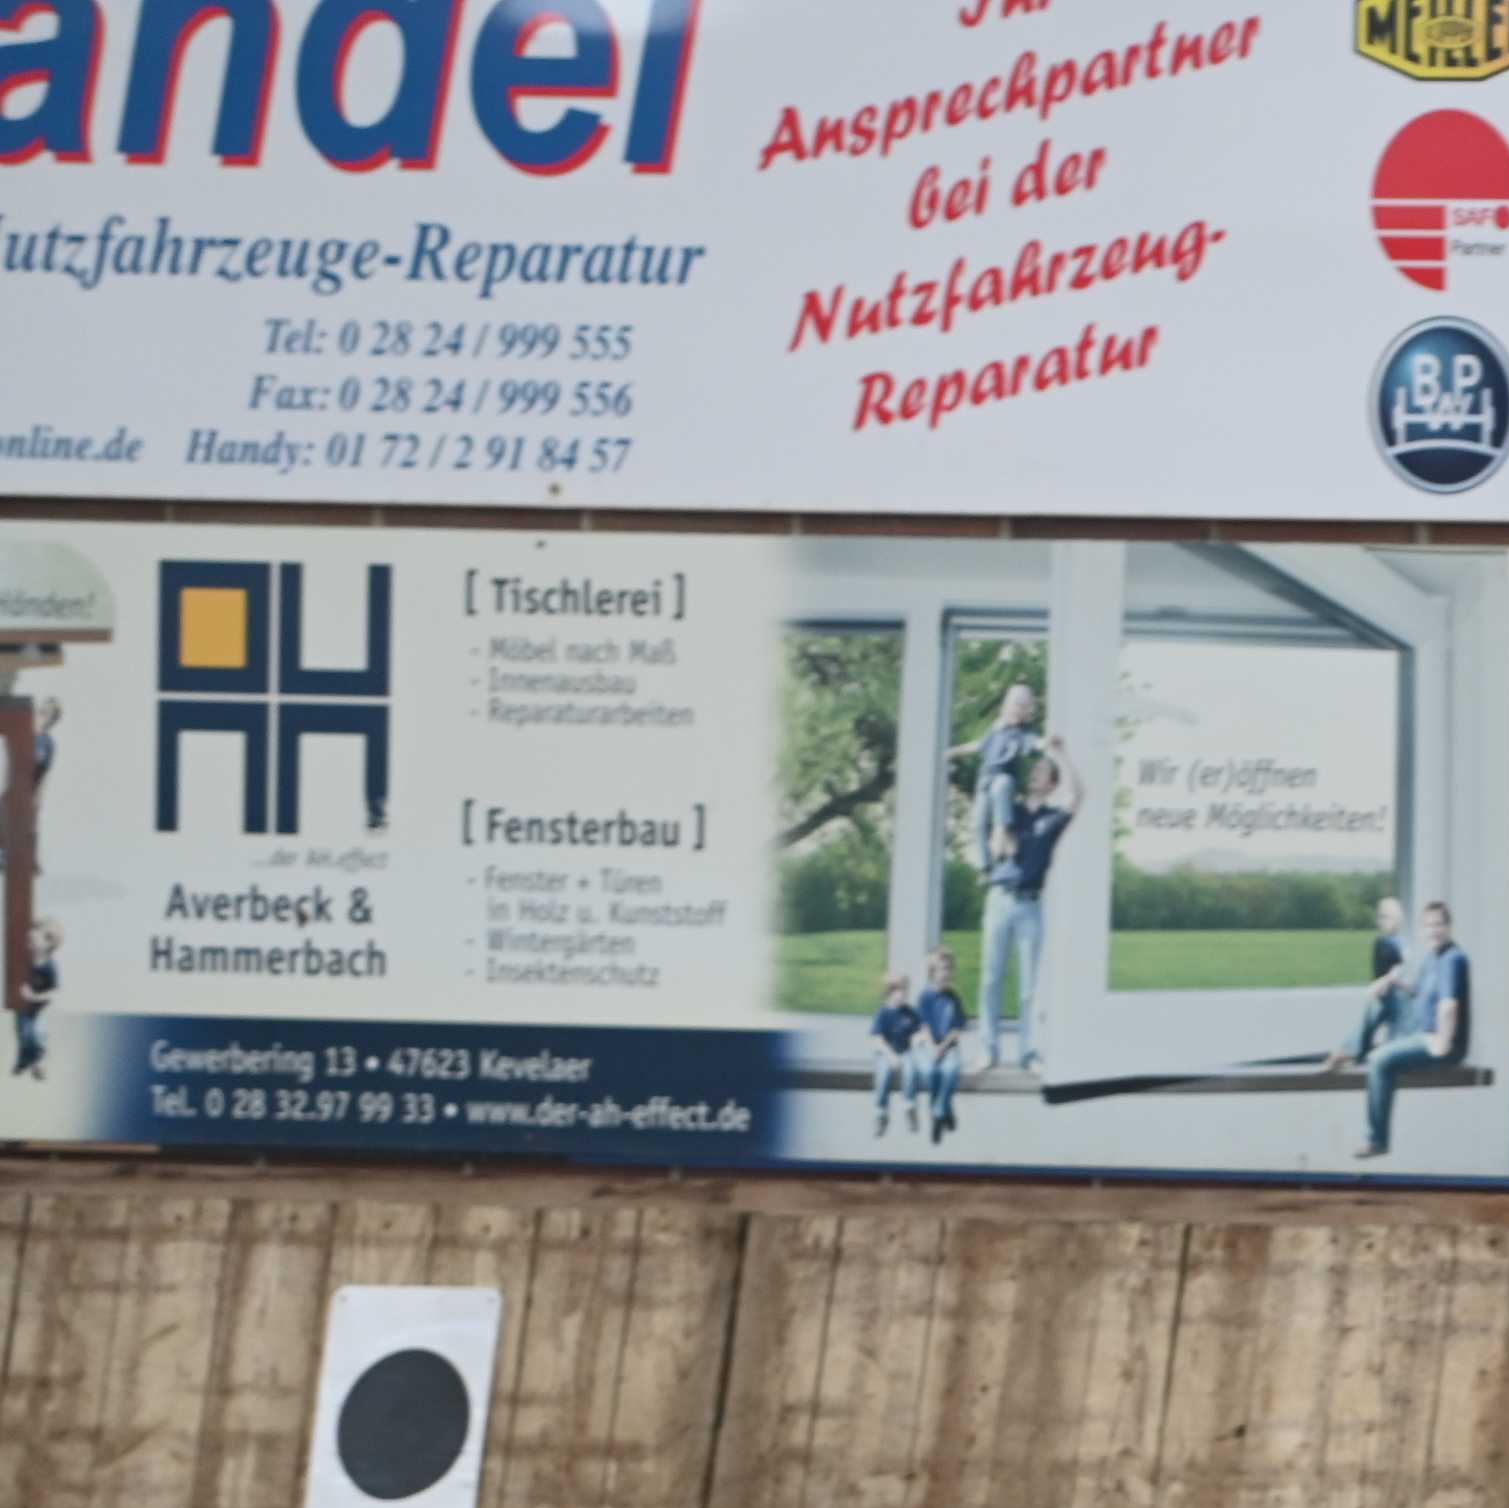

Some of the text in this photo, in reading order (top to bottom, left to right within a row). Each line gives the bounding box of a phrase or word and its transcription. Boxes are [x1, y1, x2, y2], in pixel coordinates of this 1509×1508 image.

[758, 17, 1261, 171] Ansprechpartner
[908, 139, 1106, 230] bei der
[0, 213, 705, 298] utzfahrzeuge-Reparatur
[786, 221, 1226, 352] Nutzfahrzeug-
[264, 318, 328, 355] Tel:
[370, 320, 413, 356] 28
[421, 321, 466, 357] 24
[498, 323, 560, 359] 999
[570, 324, 634, 360] 555
[249, 374, 331, 411] Fax:
[370, 376, 413, 412] 28
[421, 378, 467, 414] 24
[498, 380, 561, 415] 999
[570, 381, 634, 417] 556
[853, 325, 1160, 430] Reparatur
[186, 428, 313, 474] Handy:
[326, 432, 366, 467] 01
[381, 433, 420, 468] 72
[486, 437, 525, 471] 91
[537, 438, 579, 471] 84
[589, 439, 633, 473] 57
[490, 577, 662, 616] Tischlerei
[486, 806, 681, 847] Fensterbau
[164, 882, 373, 924] Averbeck &
[150, 935, 387, 976] Hammerbach
[151, 1039, 592, 1083] Gewerbering 13 47623 Kevelaer
[152, 1085, 197, 1117] Tel.
[231, 1089, 266, 1119] 28
[359, 1091, 394, 1123] 99
[402, 1093, 436, 1124] 33
[466, 1094, 751, 1132] www.der-ah-effect.de
